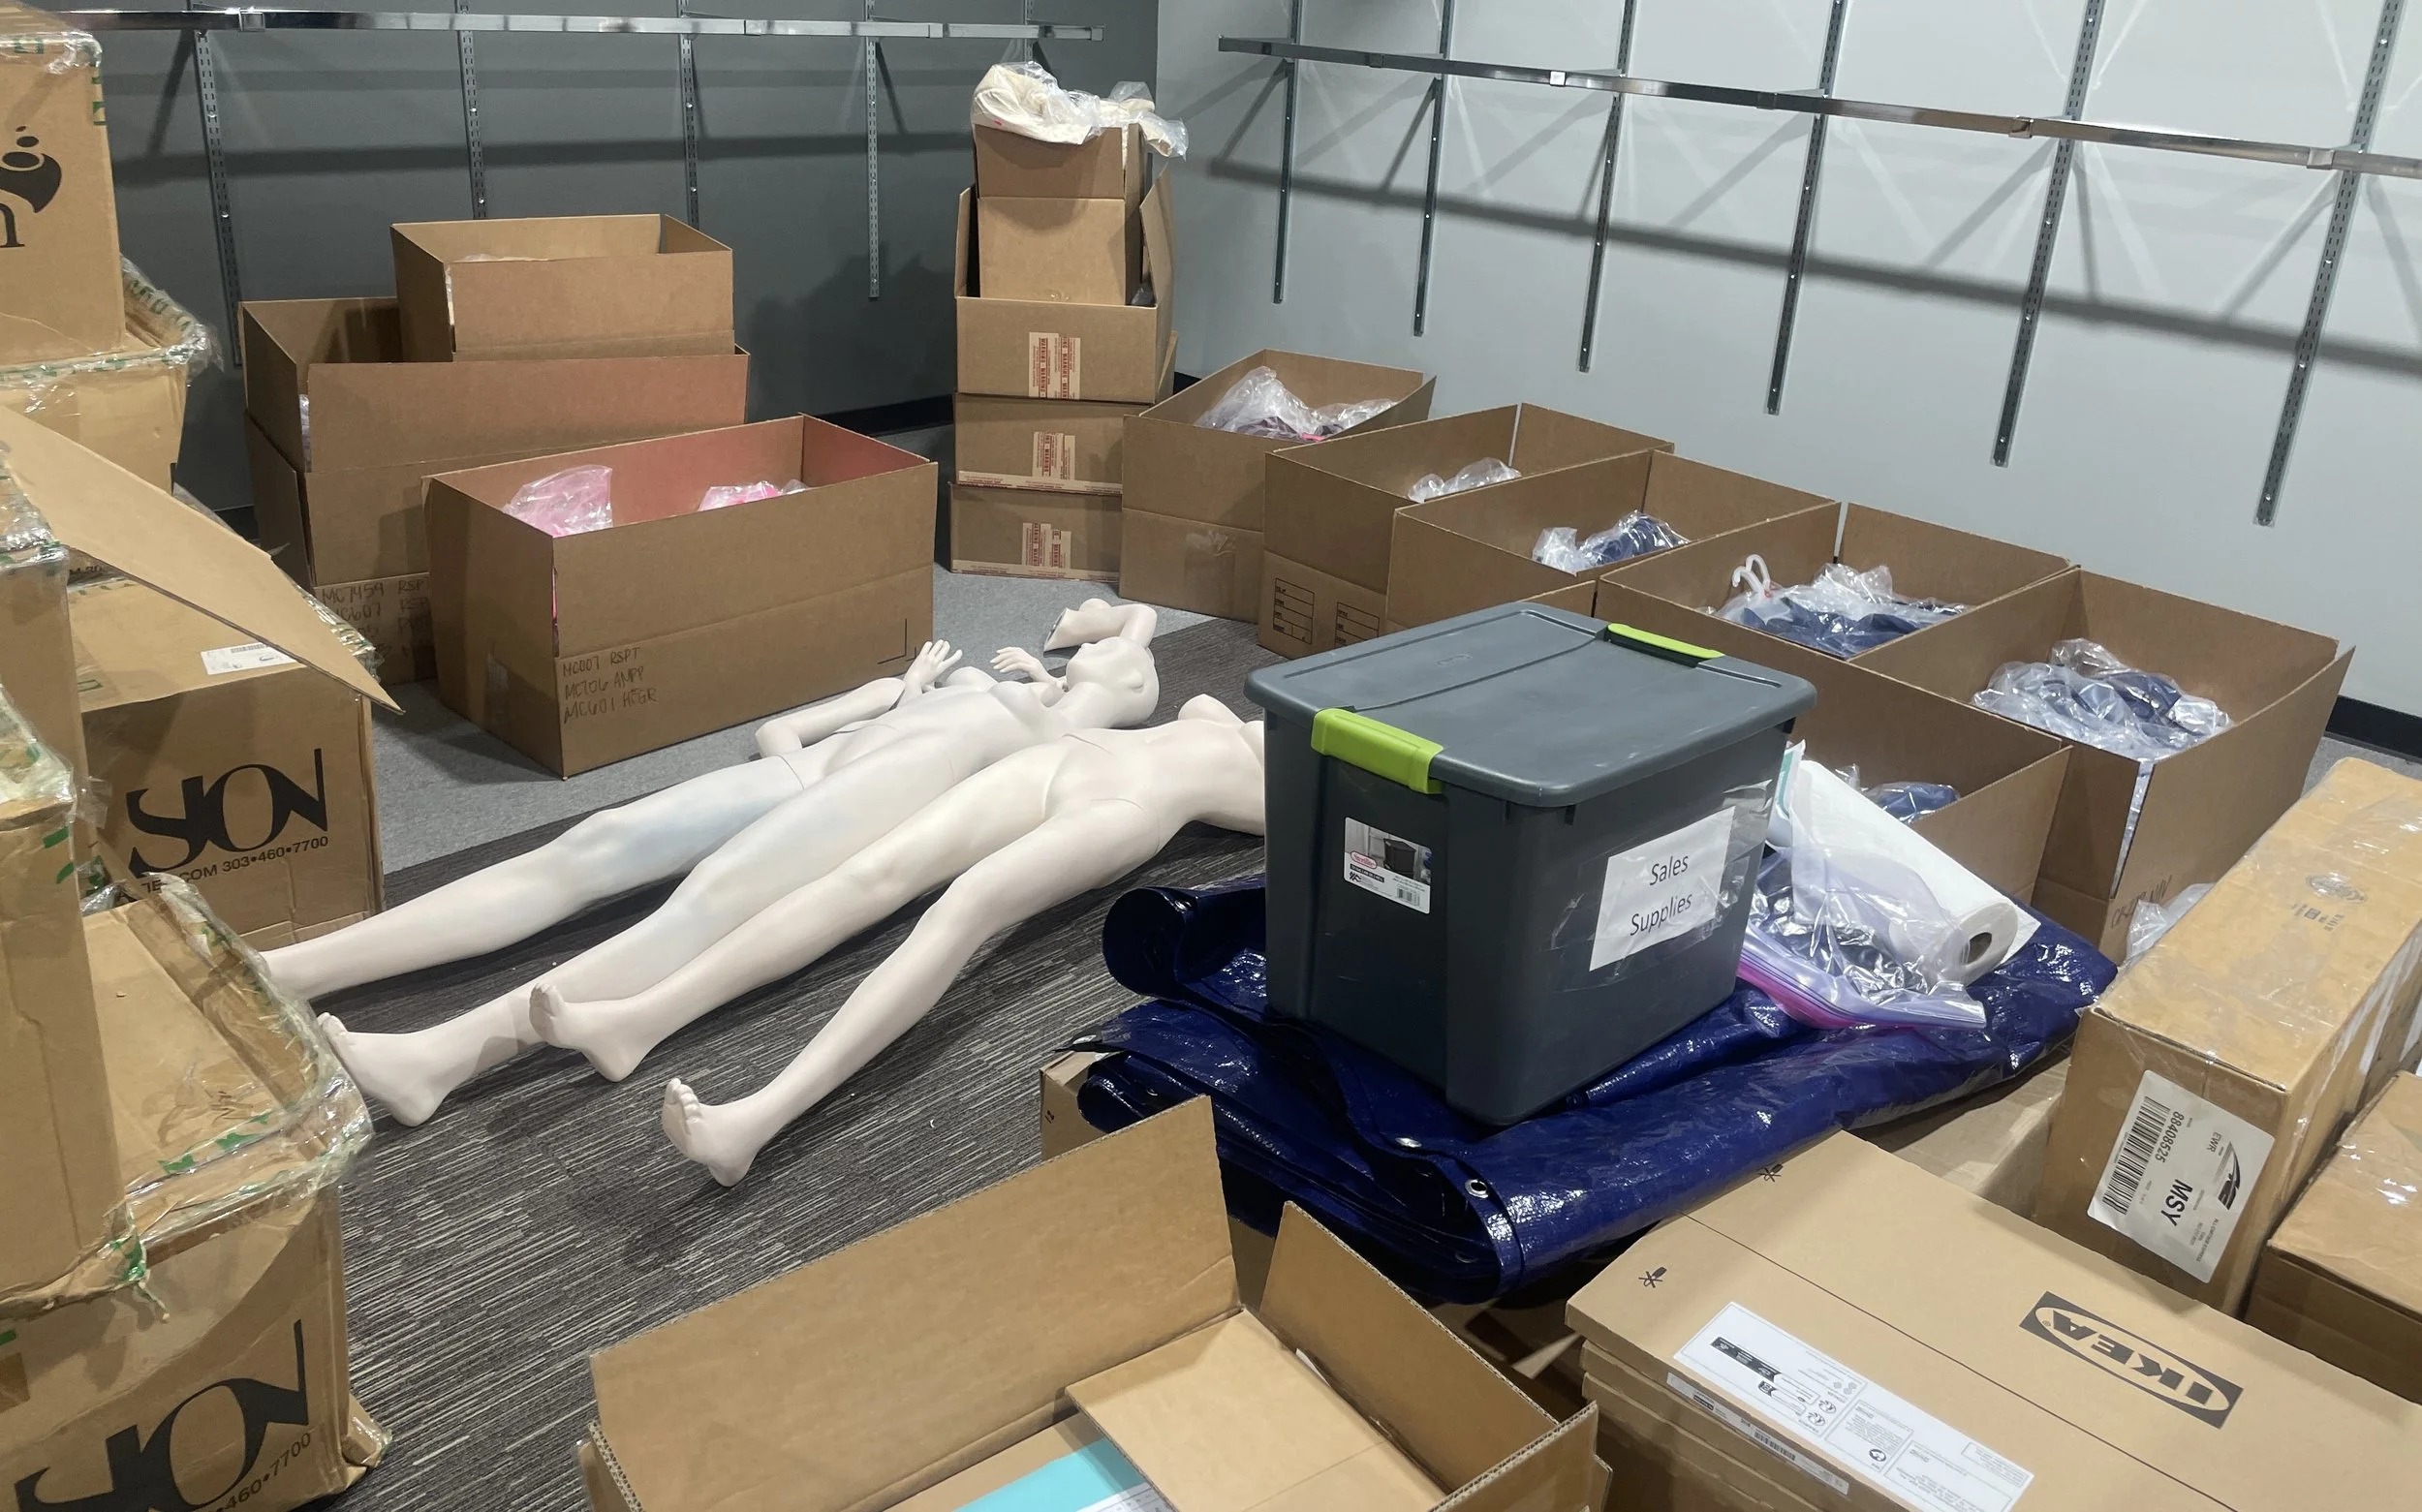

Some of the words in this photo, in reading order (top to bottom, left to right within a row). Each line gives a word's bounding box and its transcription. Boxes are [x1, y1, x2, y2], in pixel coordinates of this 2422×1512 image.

[1650, 855, 1689, 885] Sales
[1630, 894, 1692, 937] Supplies
[2155, 1111, 2185, 1163] 88408525
[2206, 1131, 2221, 1153] EWR
[2160, 1179, 2193, 1227] MSY
[2053, 1310, 2213, 1405] IKEA
